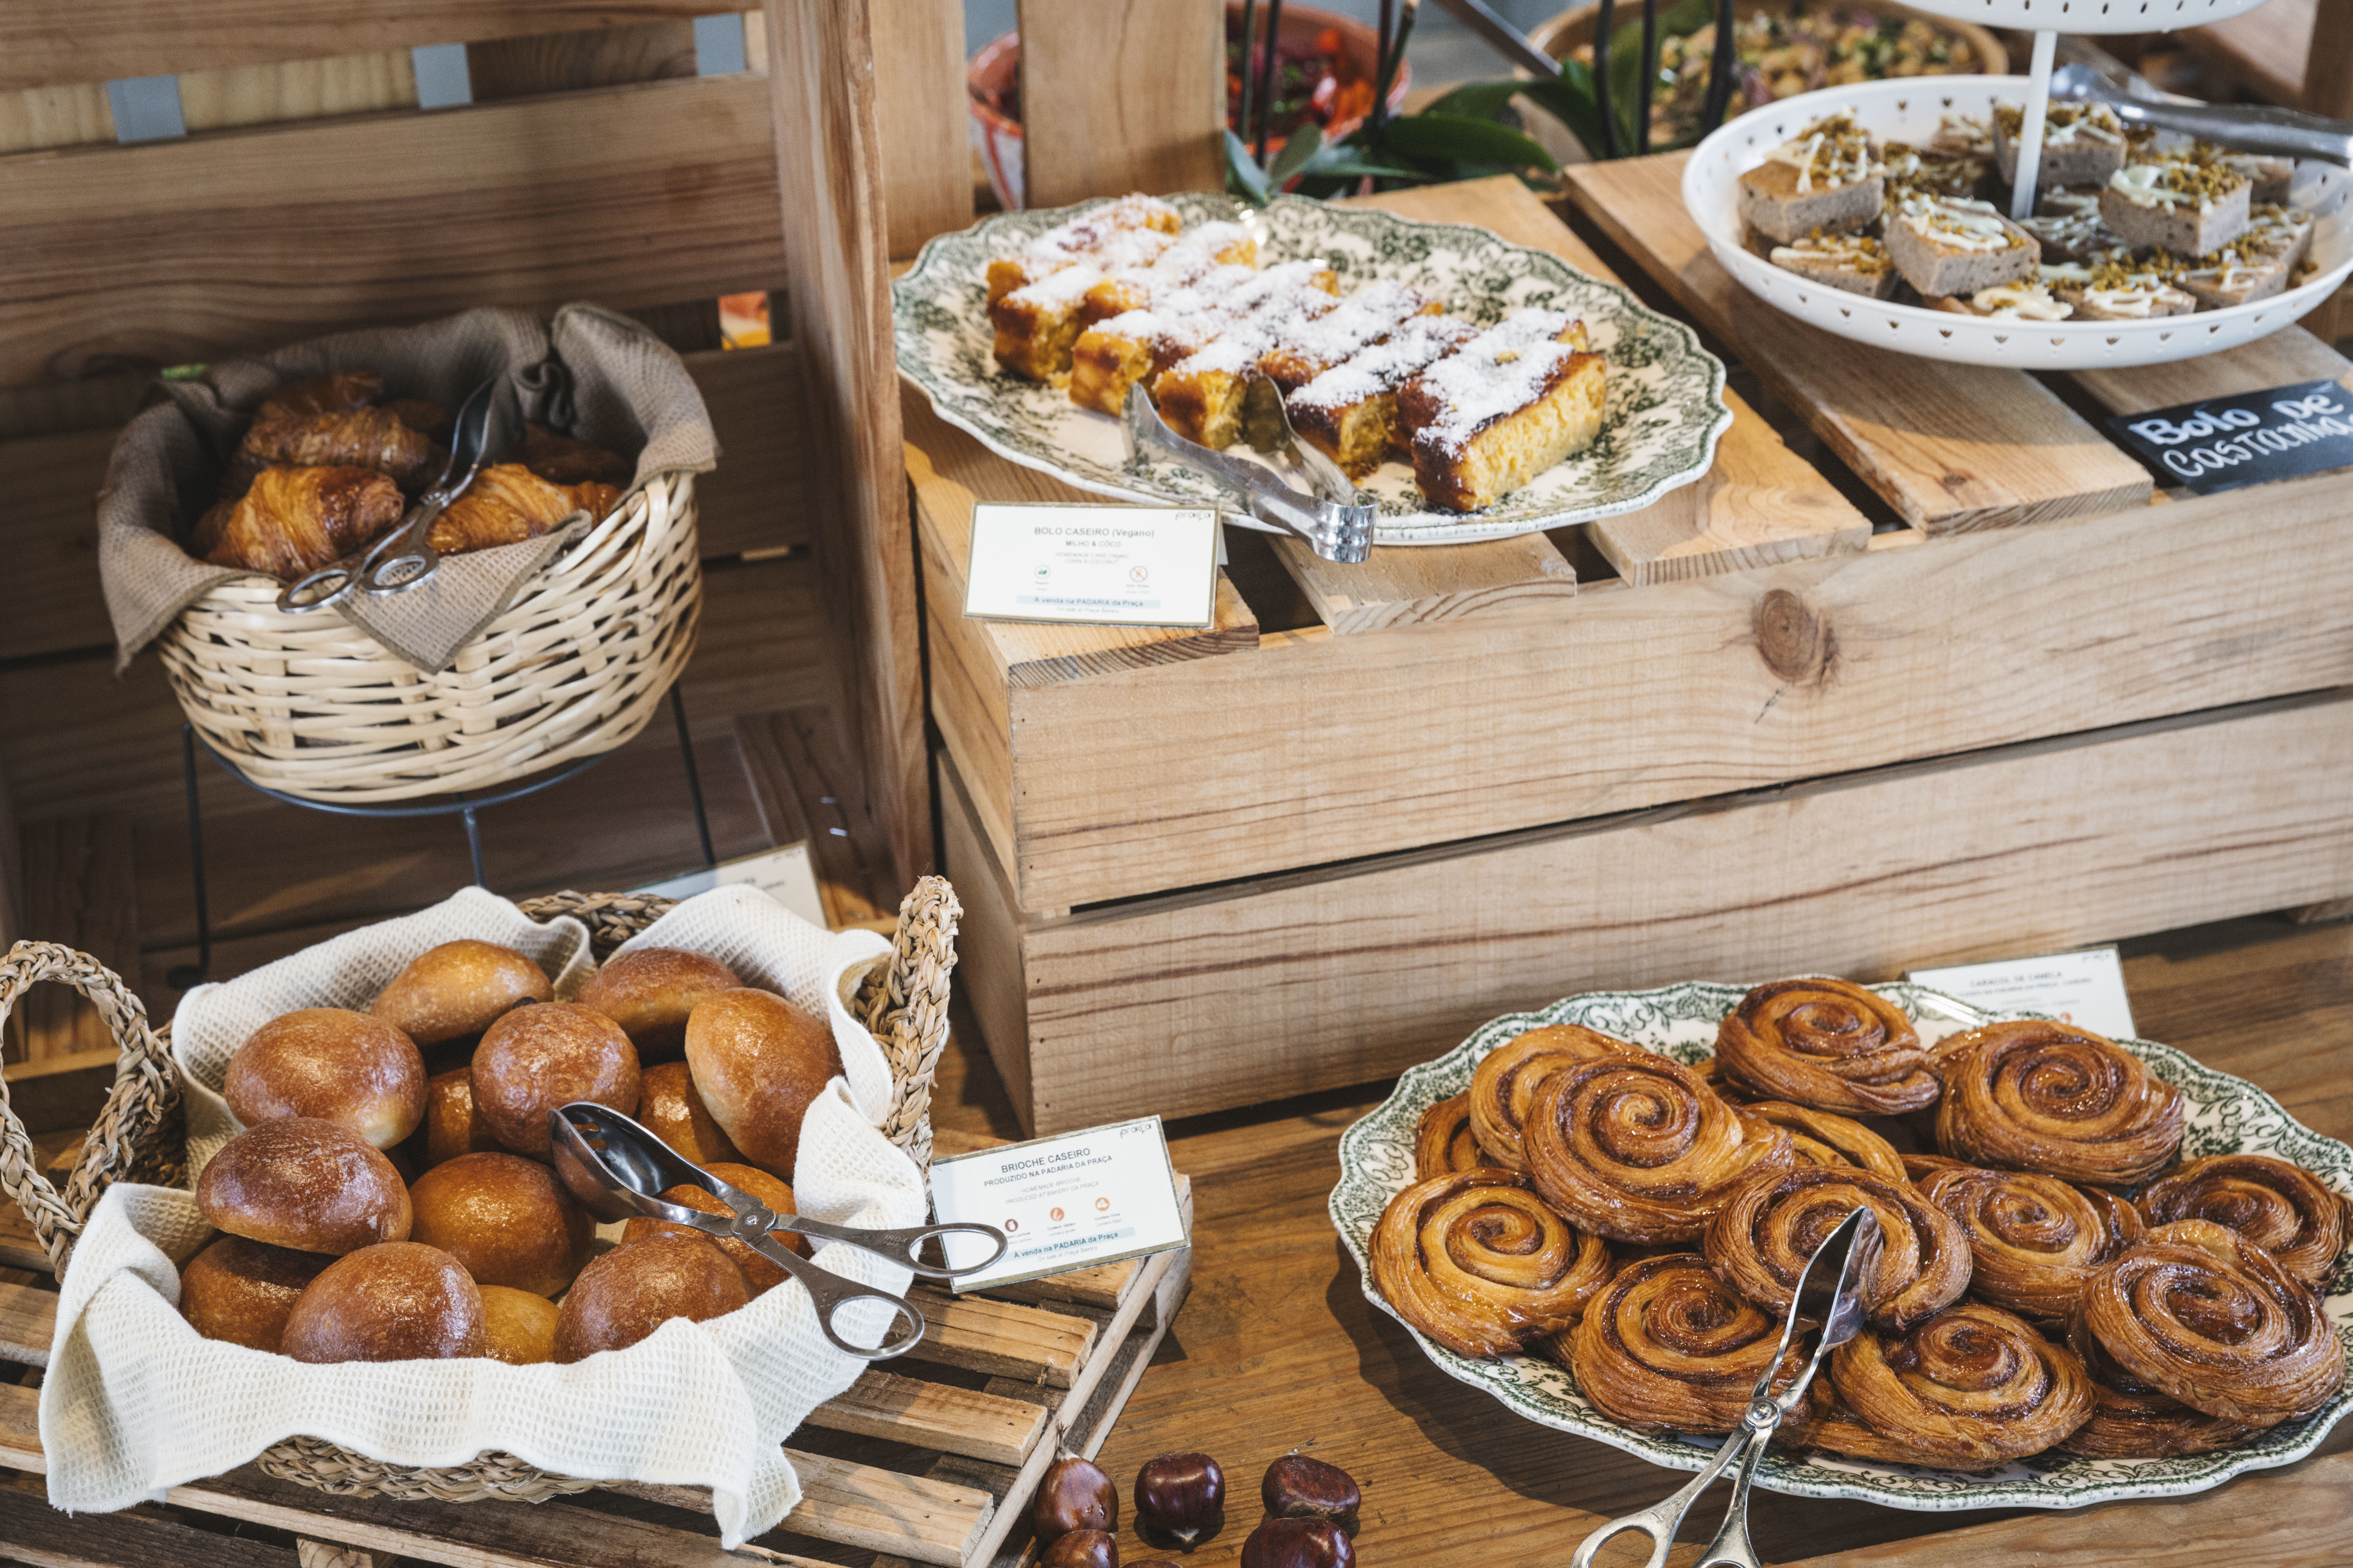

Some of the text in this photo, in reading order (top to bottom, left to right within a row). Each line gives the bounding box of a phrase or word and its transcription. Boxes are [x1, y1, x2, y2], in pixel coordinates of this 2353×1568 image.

[2128, 409, 2260, 445] Bolo
[1034, 527, 1062, 535] BOLO
[1112, 529, 1154, 538] (Vegano)
[1121, 1124, 1151, 1139] praça
[984, 1173, 1027, 1187] PRODUZIDO
[1041, 1163, 1074, 1175] PADARIA
[1088, 1155, 1112, 1165] PRAÇA
[1001, 1148, 1090, 1173] BRIOCHE CASEIRO
[1005, 1193, 1037, 1205] PRODUCED
[1047, 1187, 1069, 1196] BAKERY
[1080, 1181, 1099, 1190] PRAÇA
[1022, 1177, 1081, 1193] HOMEMADE BRIOCHE
[1022, 1247, 1042, 1257] venda
[1054, 1239, 1086, 1250] PADARIA
[1098, 1232, 1118, 1241] Praça
[1065, 1249, 1079, 1257] Praça
[1081, 1245, 1098, 1254] Bakery
